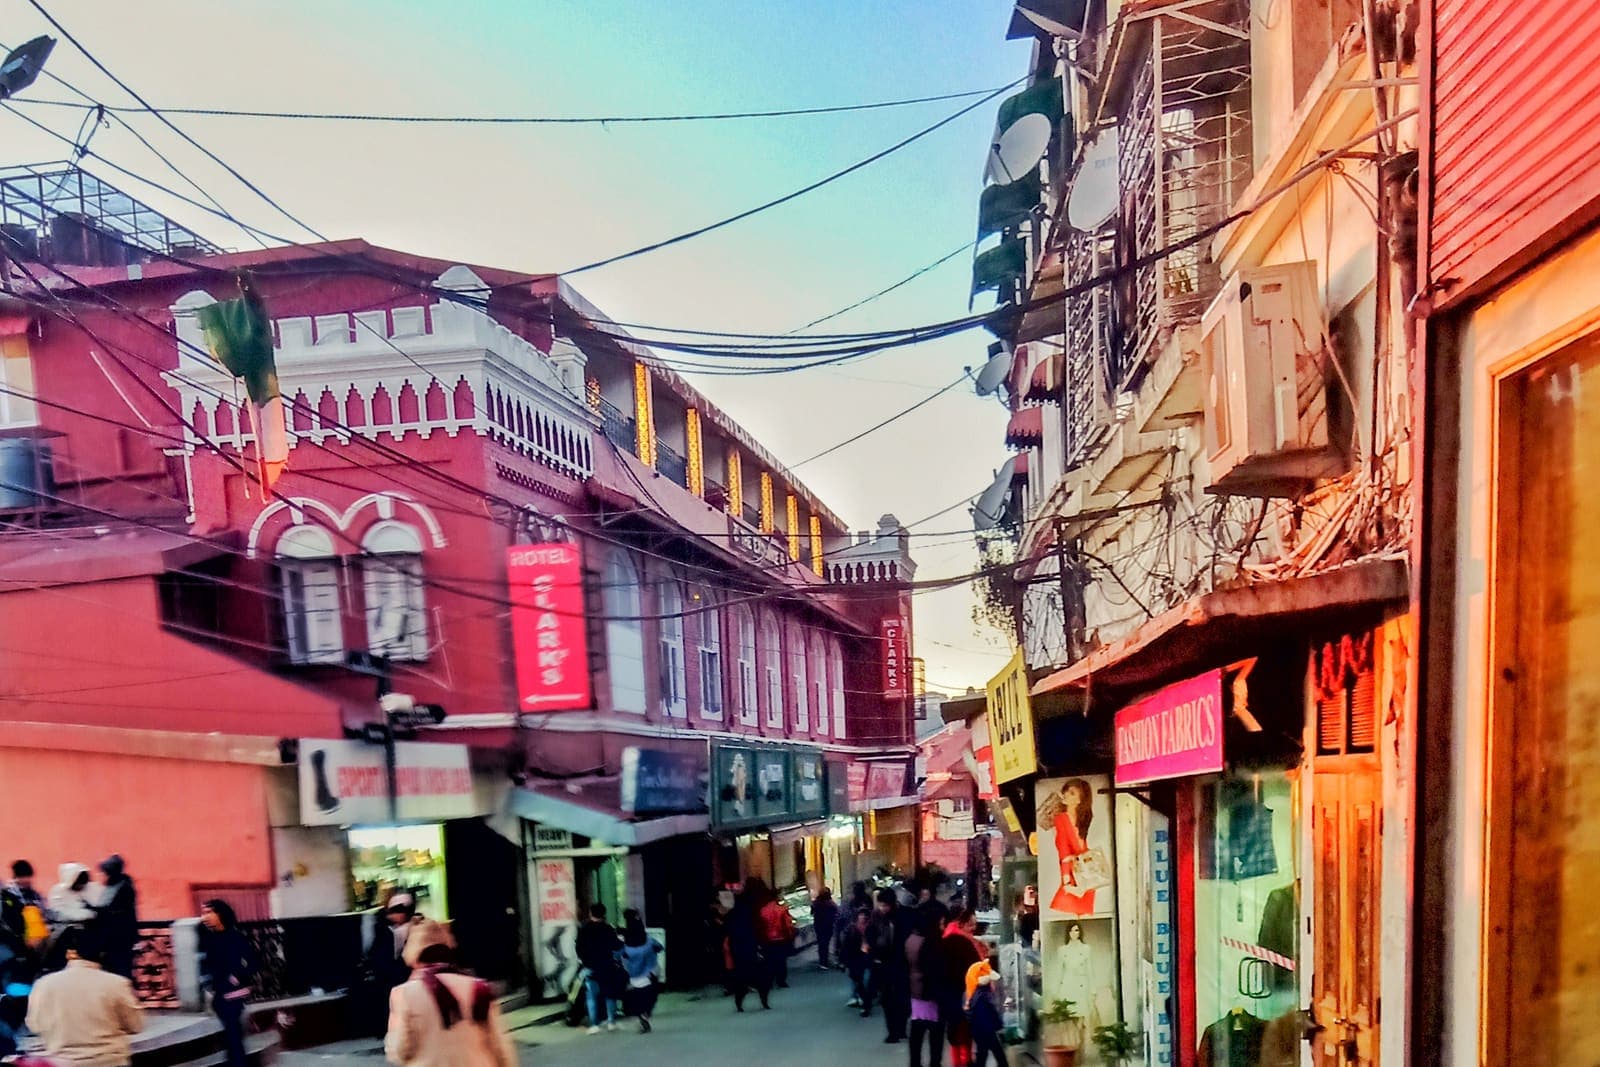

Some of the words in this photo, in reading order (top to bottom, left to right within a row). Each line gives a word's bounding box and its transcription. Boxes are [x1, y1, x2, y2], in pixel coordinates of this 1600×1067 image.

[511, 547, 573, 567] HOTEL
[1118, 713, 1161, 766] FASHION
[1161, 693, 1216, 756] FABRICS
[1155, 829, 1170, 903] BLUE
[1156, 922, 1170, 994] BLUE
[1158, 1013, 1172, 1064] BLU
